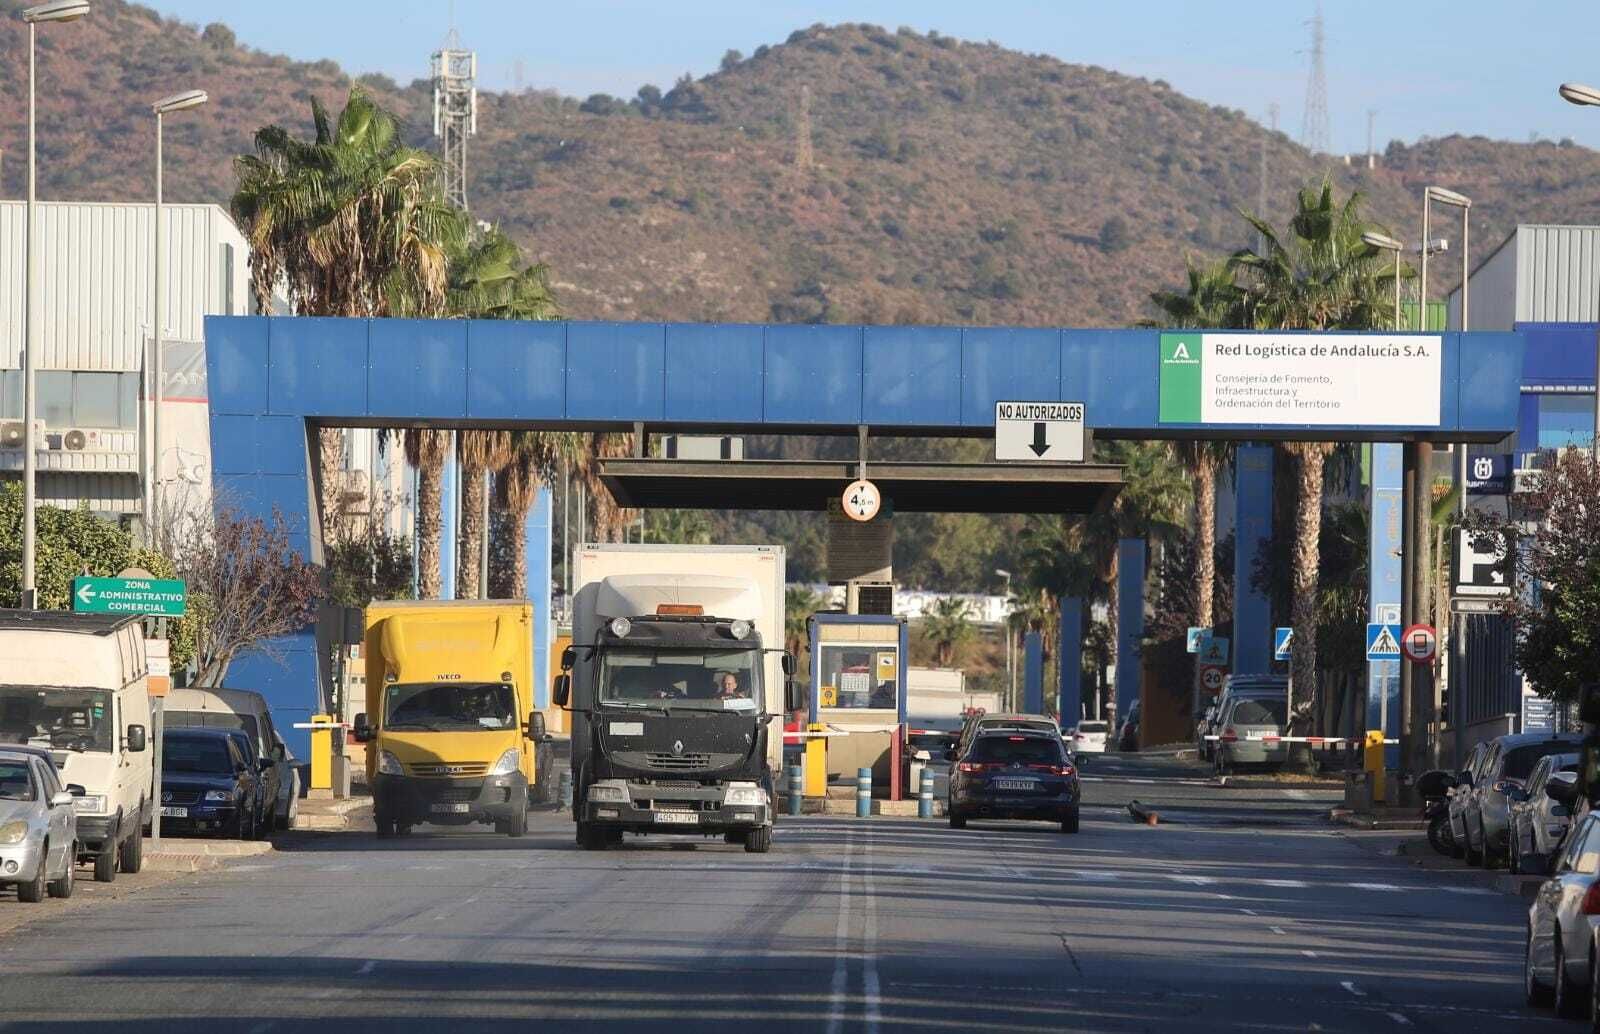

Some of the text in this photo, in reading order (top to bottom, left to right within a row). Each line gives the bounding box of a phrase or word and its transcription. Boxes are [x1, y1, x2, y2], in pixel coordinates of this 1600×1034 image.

[1215, 342, 1430, 360] Red Logística de Andalucía S.A.
[1215, 373, 1334, 386] Consejería de Fomento,
[1215, 386, 1299, 399] Infraestructura y
[1214, 397, 1341, 409] Ordenación del Territorio
[999, 405, 1082, 420] NO AUTORIZADOS
[124, 580, 151, 590] ZONA
[99, 591, 183, 602] ADMINISTRATIVO
[108, 602, 166, 612] COMERCIAL
[1206, 671, 1221, 684] 20
